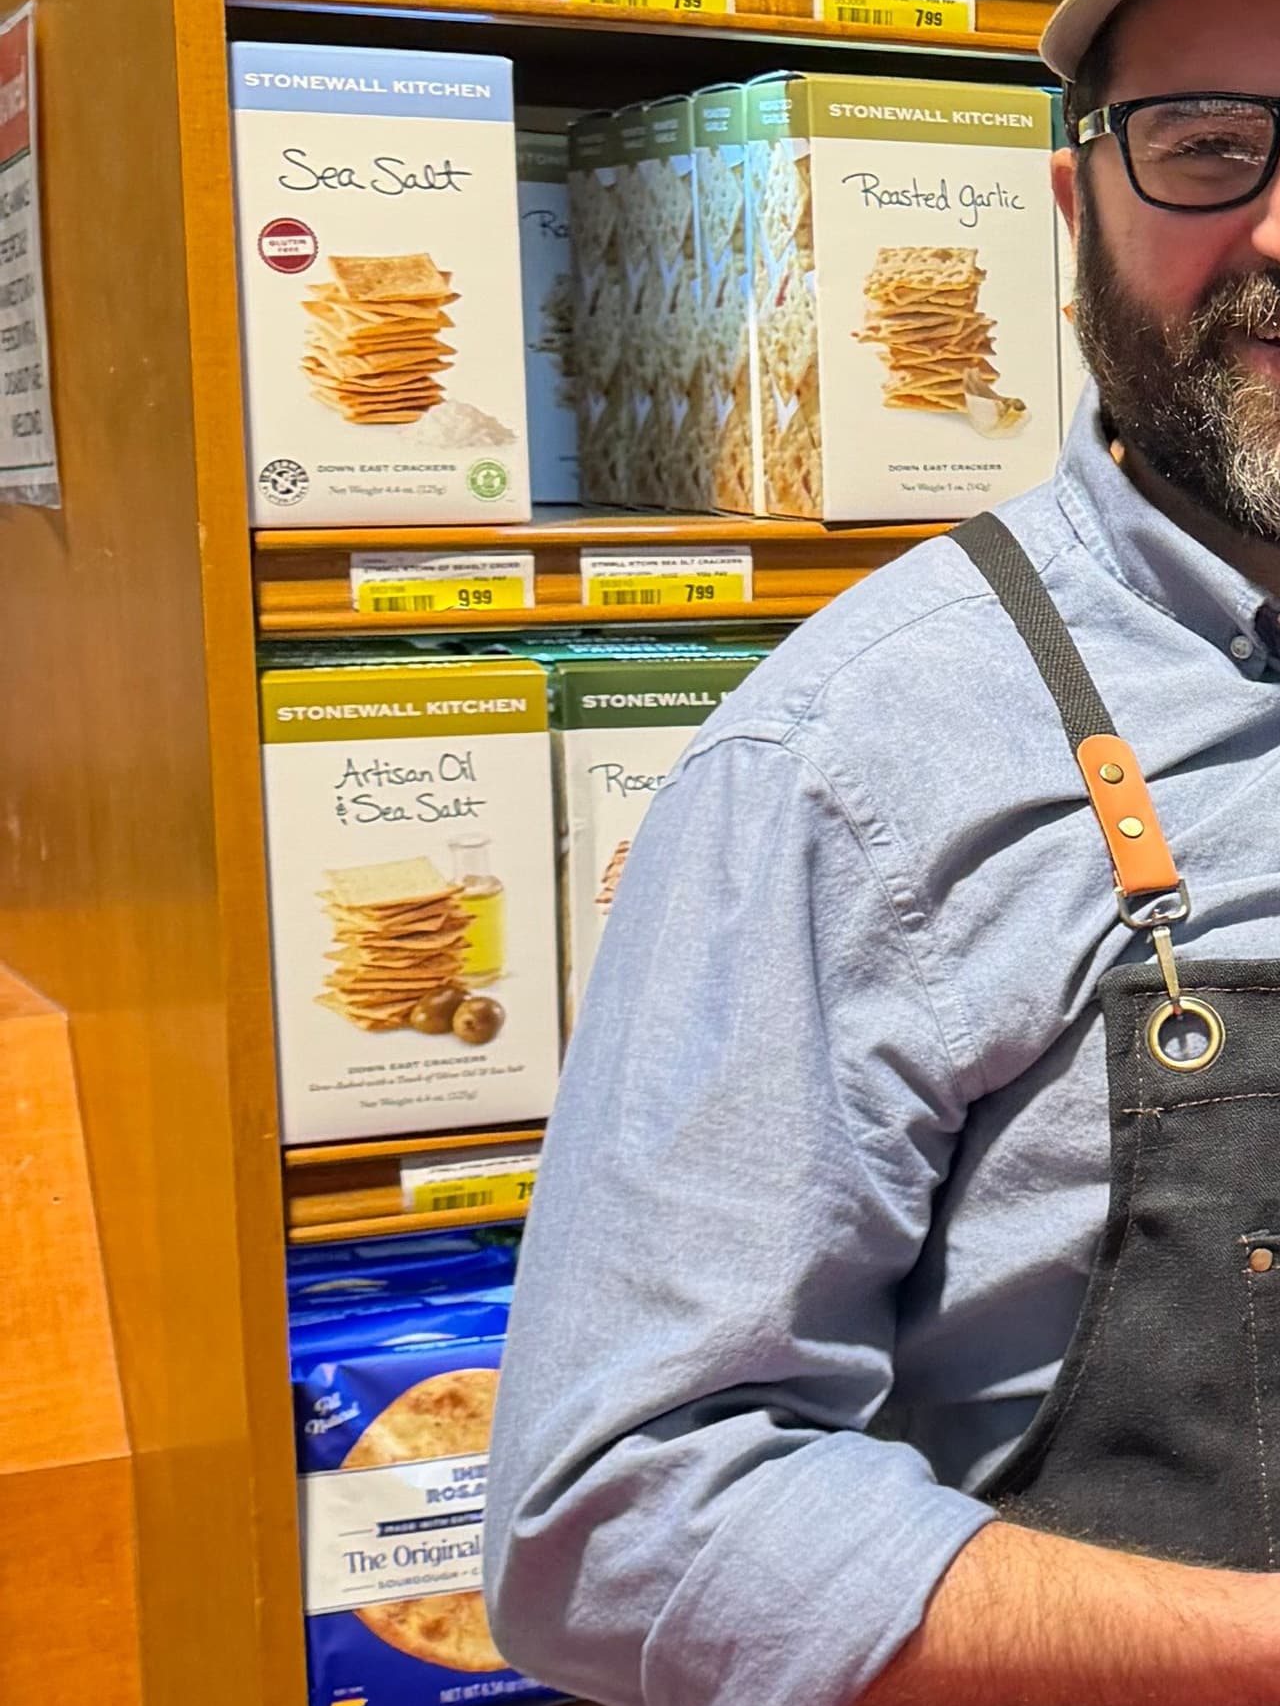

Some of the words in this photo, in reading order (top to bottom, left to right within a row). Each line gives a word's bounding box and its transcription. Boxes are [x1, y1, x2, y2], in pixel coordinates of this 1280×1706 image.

[244, 72, 388, 94] STONEWALL
[393, 80, 491, 98] KITCHEN
[278, 148, 366, 192] Sea
[372, 157, 472, 195] Salt
[277, 701, 421, 721] STONEWALL
[426, 698, 527, 716] KITCHEN
[335, 751, 434, 790] Artisan
[438, 752, 476, 783] Oil
[354, 794, 413, 823] Sea
[416, 794, 486, 823] Salt
[342, 1549, 387, 1574] The
[393, 1539, 482, 1566] Original
